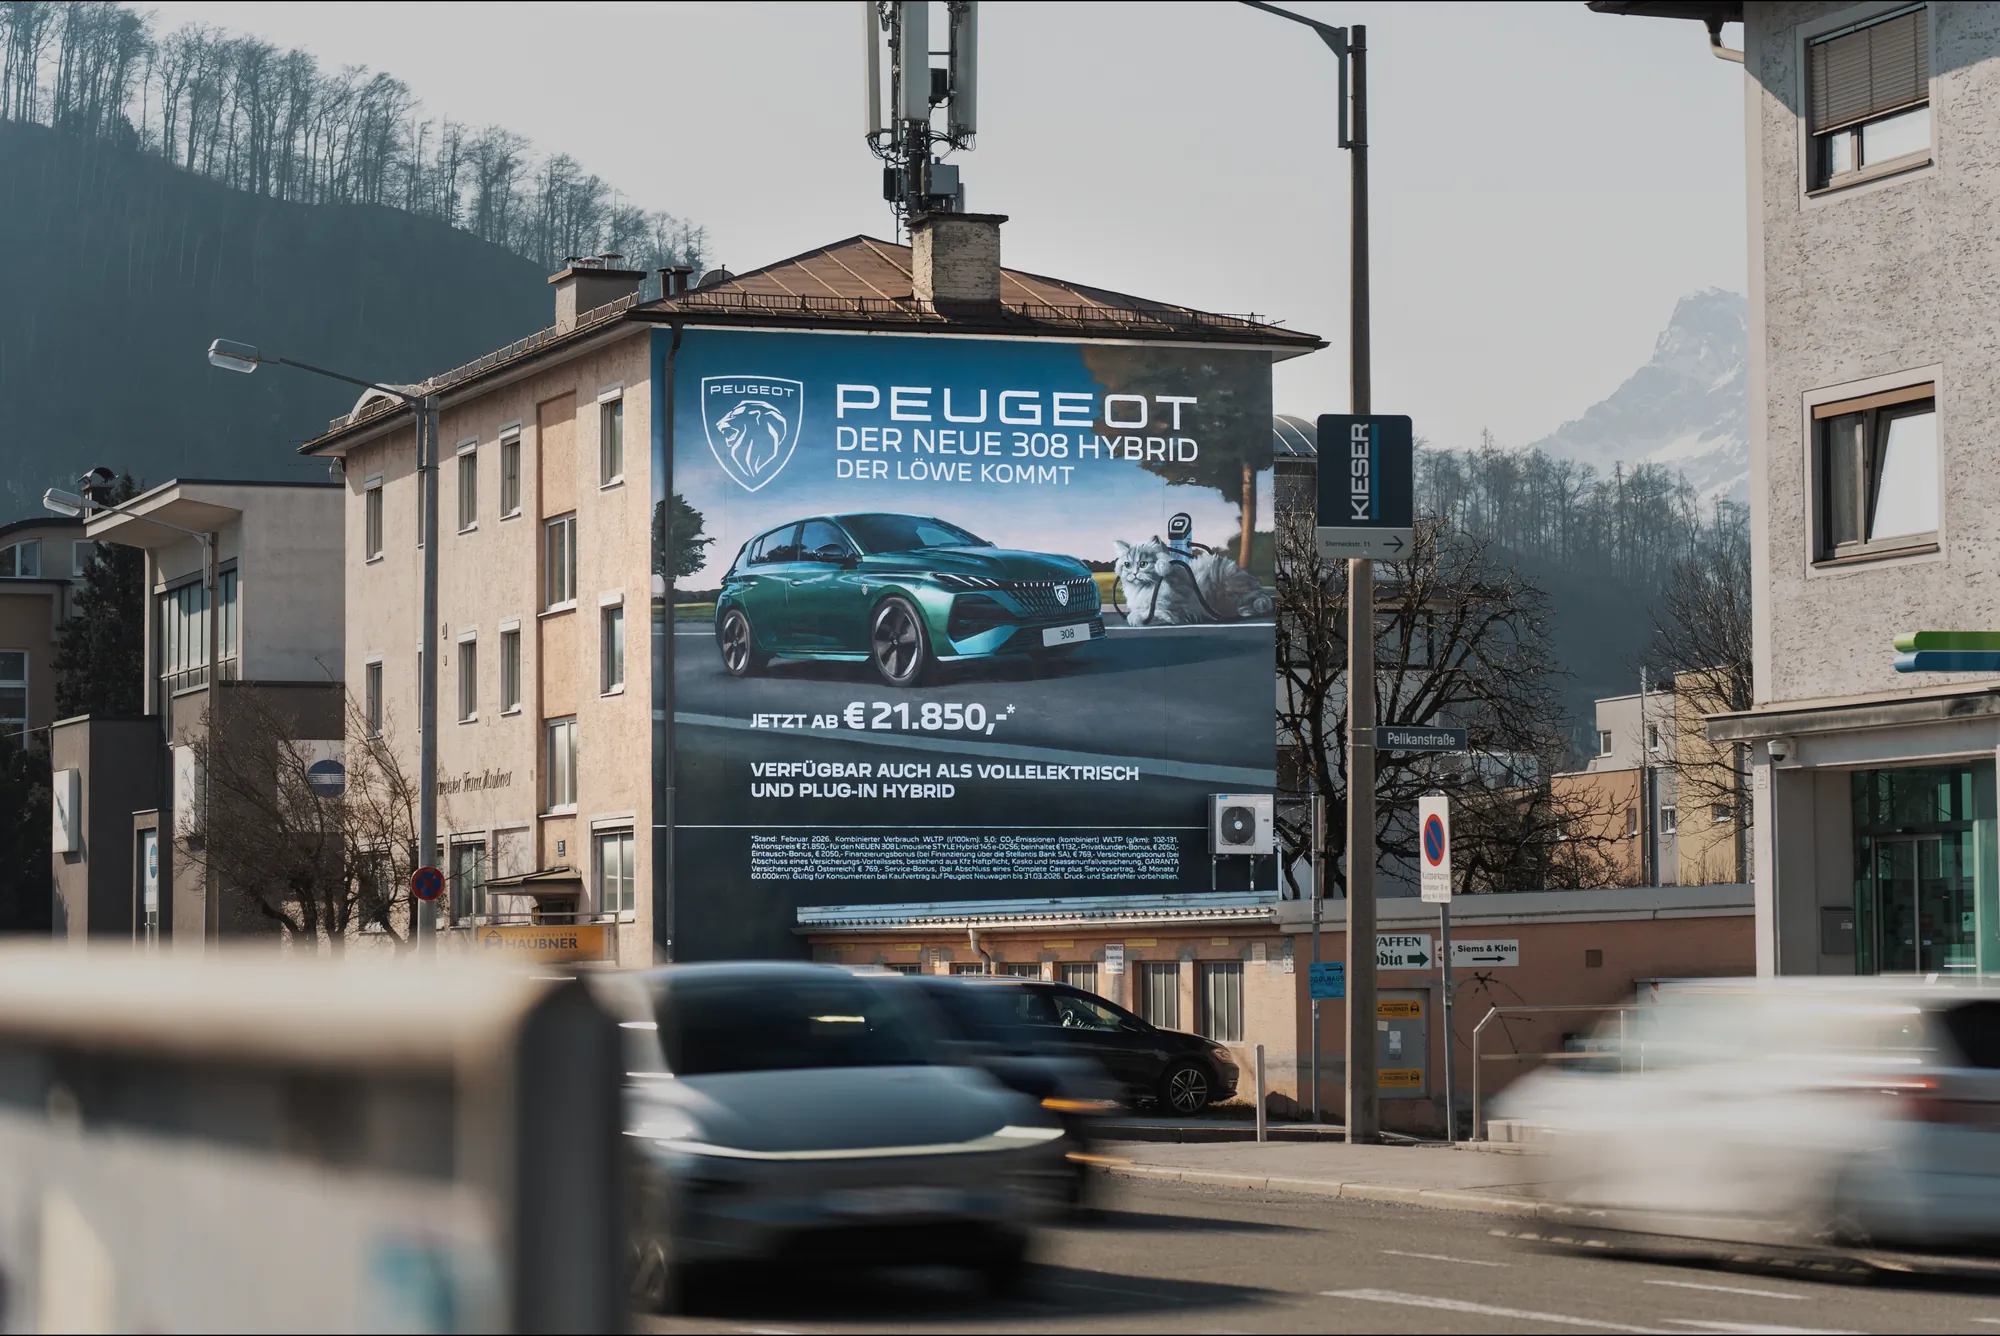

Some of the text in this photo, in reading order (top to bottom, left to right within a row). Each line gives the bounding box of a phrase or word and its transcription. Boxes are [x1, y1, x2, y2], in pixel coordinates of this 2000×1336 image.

[710, 383, 795, 399] PEUGEOT
[836, 383, 1198, 430] PEUGEOT
[836, 427, 1199, 462] DER NEUE 308 HYBRID
[836, 458, 1075, 485] DER LÖWE KOMMT
[1351, 422, 1370, 520] KIESER
[1059, 628, 1076, 640] 308
[750, 713, 807, 730] JETZT
[811, 714, 838, 730] AB
[1387, 732, 1456, 746] Pelikanstraße
[751, 760, 1140, 781] VERFÜGBAR AUCH ALS VOLLELEKTRISCH
[751, 783, 956, 799] UND PLUG-IN HYBRID
[751, 843, 795, 851] Aktionspreis
[830, 843, 840, 851] für
[841, 843, 854, 851] den
[855, 843, 881, 851] NEUEN
[882, 843, 895, 851] 308
[896, 843, 931, 851] Limousine
[932, 843, 955, 851] STYLE
[956, 843, 978, 851] Hybrid
[980, 843, 991, 851] 145
[751, 858, 788, 866] Abschluss
[790, 858, 808, 866] eines
[1006, 851, 1037, 859] Stellantis
[1038, 851, 1056, 859] Bank
[1097, 851, 1165, 859] Versicherungsbonus
[1167, 851, 1179, 859] (bei
[931, 873, 942, 881] auf
[944, 873, 973, 881] Peugeot
[974, 873, 1011, 881] Neuwagen
[1012, 873, 1023, 881] bis
[1138, 866, 1147, 874] 48
[1149, 866, 1174, 874] Monate
[506, 938, 578, 949] HAUBNER
[1457, 945, 1484, 953] Siems
[1494, 944, 1517, 953] Klein
